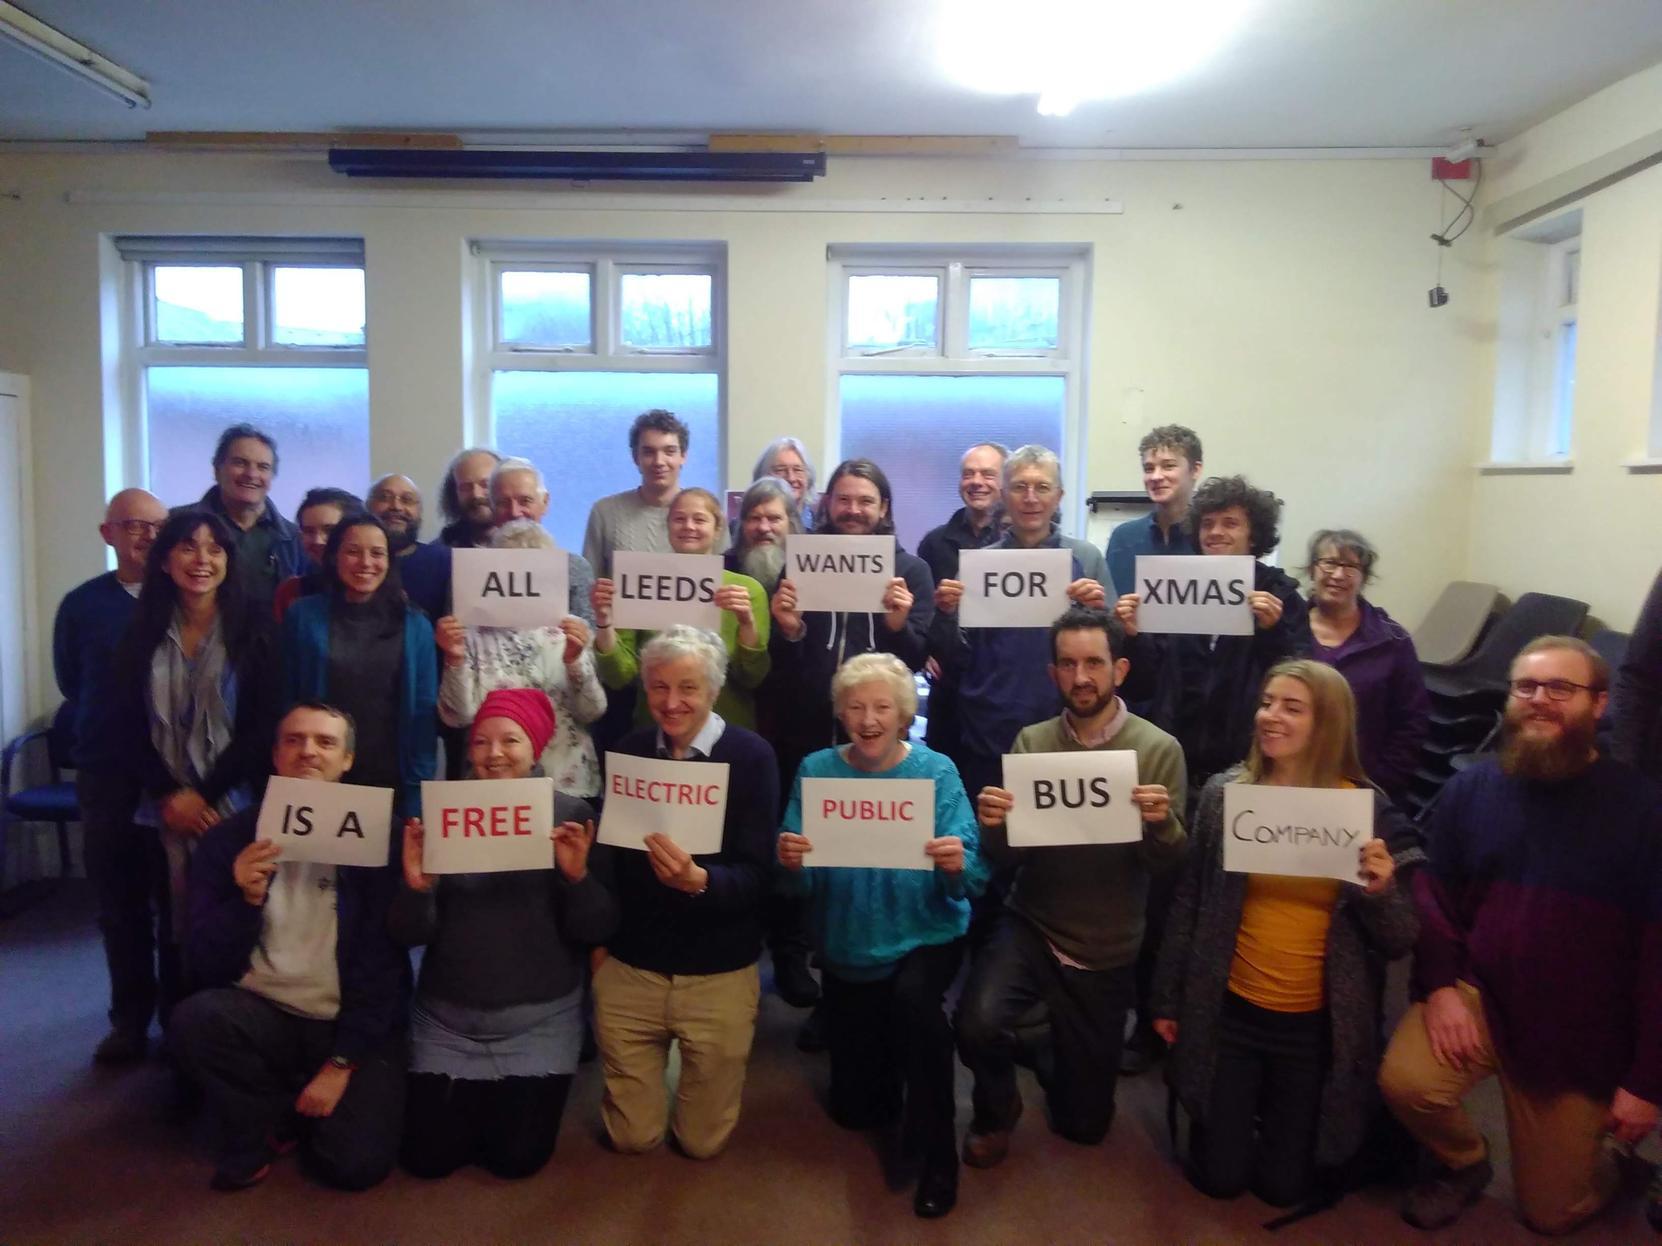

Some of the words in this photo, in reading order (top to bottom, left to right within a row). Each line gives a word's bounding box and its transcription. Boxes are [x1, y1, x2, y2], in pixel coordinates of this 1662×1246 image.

[795, 553, 883, 574] WANTS
[482, 571, 541, 598] ALL
[621, 573, 716, 603] LEEDS
[983, 571, 1048, 598] FOR
[1142, 578, 1247, 606] XMAS
[612, 774, 720, 806] ELECTRIC
[1033, 777, 1111, 810] BUS
[281, 804, 314, 837] IS
[336, 811, 365, 839] A
[441, 805, 532, 839] FREE
[822, 799, 915, 821] PUBLIC
